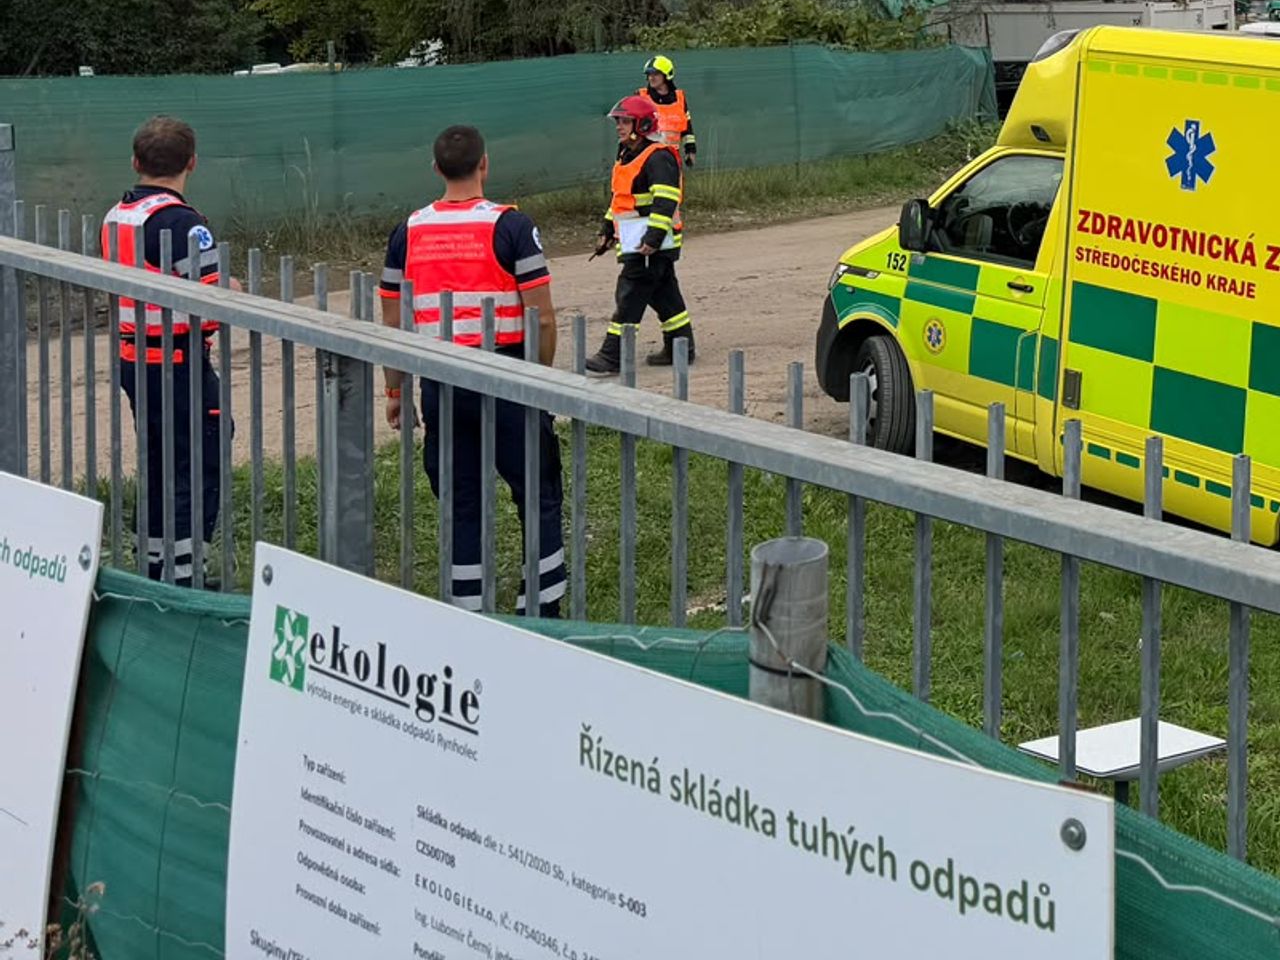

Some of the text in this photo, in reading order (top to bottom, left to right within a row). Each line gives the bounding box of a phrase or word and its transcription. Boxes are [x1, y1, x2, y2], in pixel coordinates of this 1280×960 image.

[1077, 209, 1257, 267] ZDRAVOTNICKÁ
[887, 252, 907, 272] 152
[1075, 244, 1256, 299] STŘEDOČESKÉHO KRAJE
[13, 546, 67, 582] odpadů
[306, 681, 331, 701] výroba
[333, 689, 361, 713] energie
[371, 707, 400, 730] skládka
[402, 721, 435, 744] odpadů
[437, 734, 477, 761] Rynholec
[303, 754, 315, 771] Typ
[301, 787, 344, 817] Identifikační
[346, 807, 362, 826] číslo
[579, 723, 1056, 932] Řízená skládka tuhých odpadů
[299, 819, 344, 850] Provozovatel
[353, 846, 377, 867] adresa
[416, 804, 447, 830] Skládka
[450, 819, 481, 845] odpadu
[483, 834, 496, 852] dle
[508, 844, 551, 876] 541/2020
[571, 872, 617, 904] kategorie
[618, 893, 647, 918] S-003
[297, 851, 366, 895] Odpovědná osoba:
[296, 884, 327, 909] Provozní
[328, 901, 347, 920] doba
[431, 916, 465, 943] Lubomír
